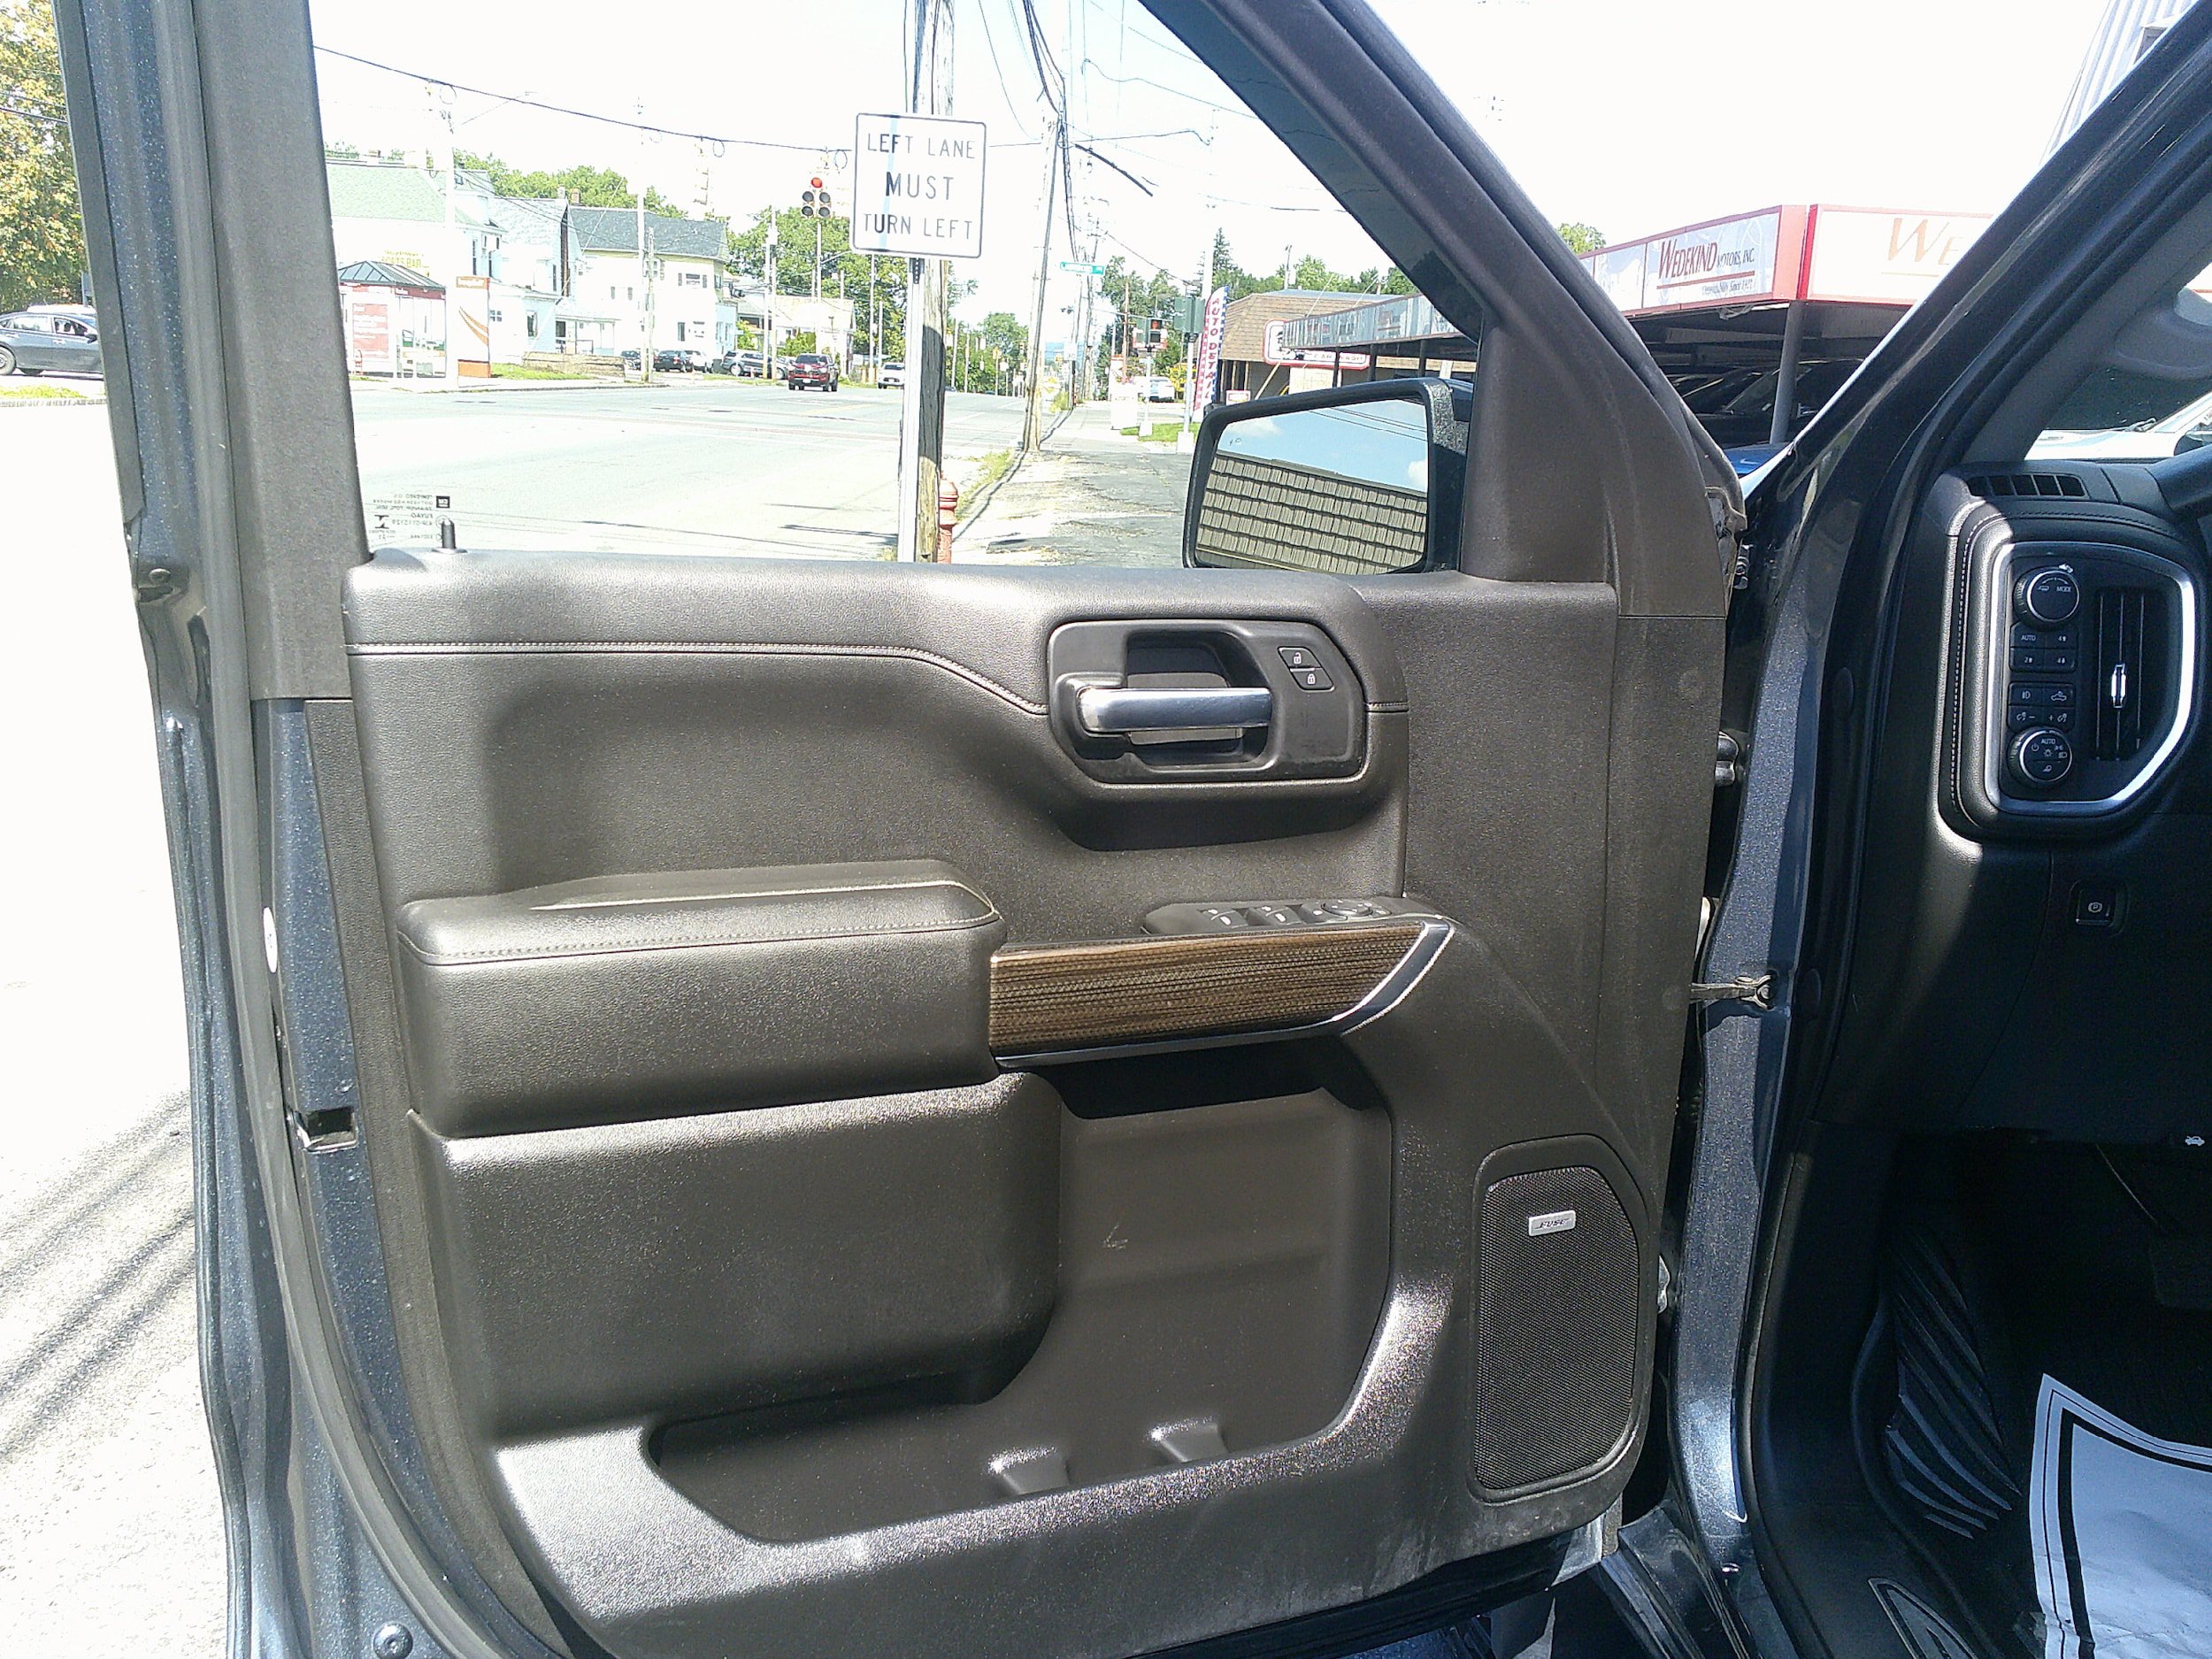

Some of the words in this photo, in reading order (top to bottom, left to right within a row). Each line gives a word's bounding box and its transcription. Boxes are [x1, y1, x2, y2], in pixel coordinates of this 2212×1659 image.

[867, 133, 913, 154] LEFT
[928, 137, 975, 159] LANE
[885, 171, 954, 200] MUST
[864, 213, 911, 234] TURN
[923, 218, 972, 240] LEFT
[1658, 238, 1718, 280] WEDEKIND
[1210, 297, 1220, 336] AUTO
[1204, 342, 1217, 399] DETAIL
